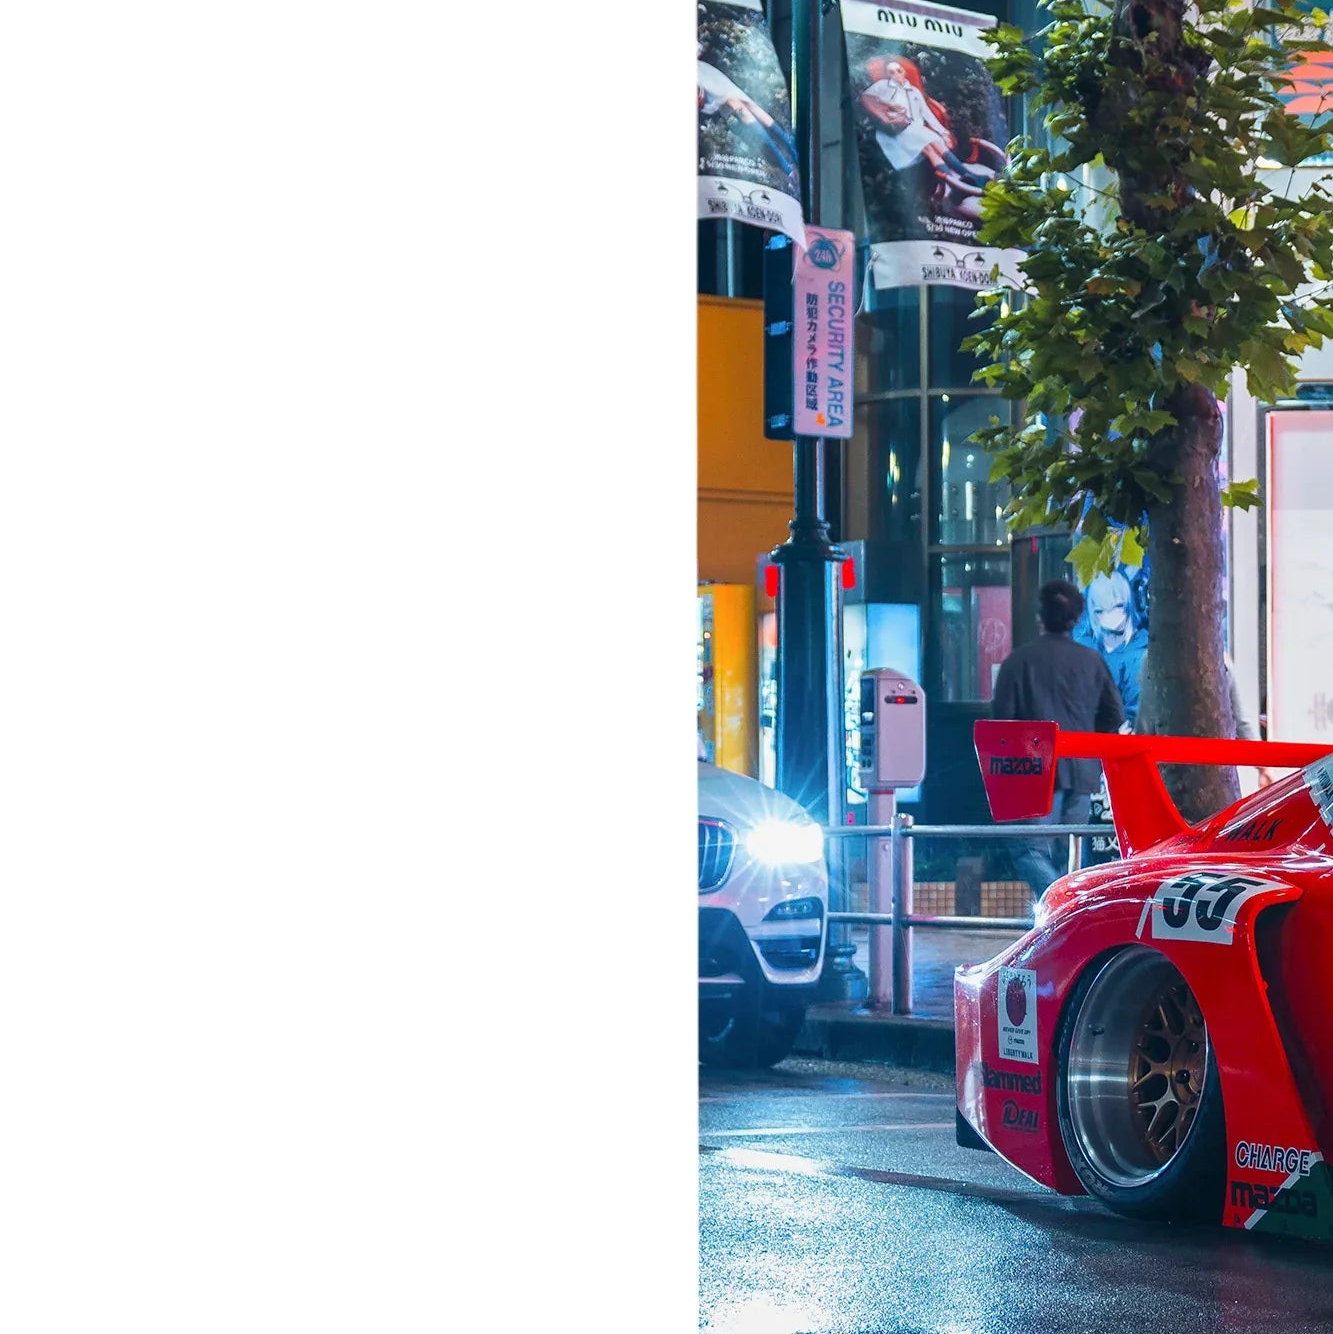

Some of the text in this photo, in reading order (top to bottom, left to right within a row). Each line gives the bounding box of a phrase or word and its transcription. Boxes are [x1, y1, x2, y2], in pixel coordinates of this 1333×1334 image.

[877, 9, 963, 38] miu miu
[815, 248, 831, 263] 24h
[922, 267, 956, 281] SHIBUYA
[827, 280, 845, 427] SECURITY AREA
[989, 757, 1043, 776] mazda
[1225, 819, 1284, 842] WALK
[1235, 1140, 1312, 1177] CHARGE
